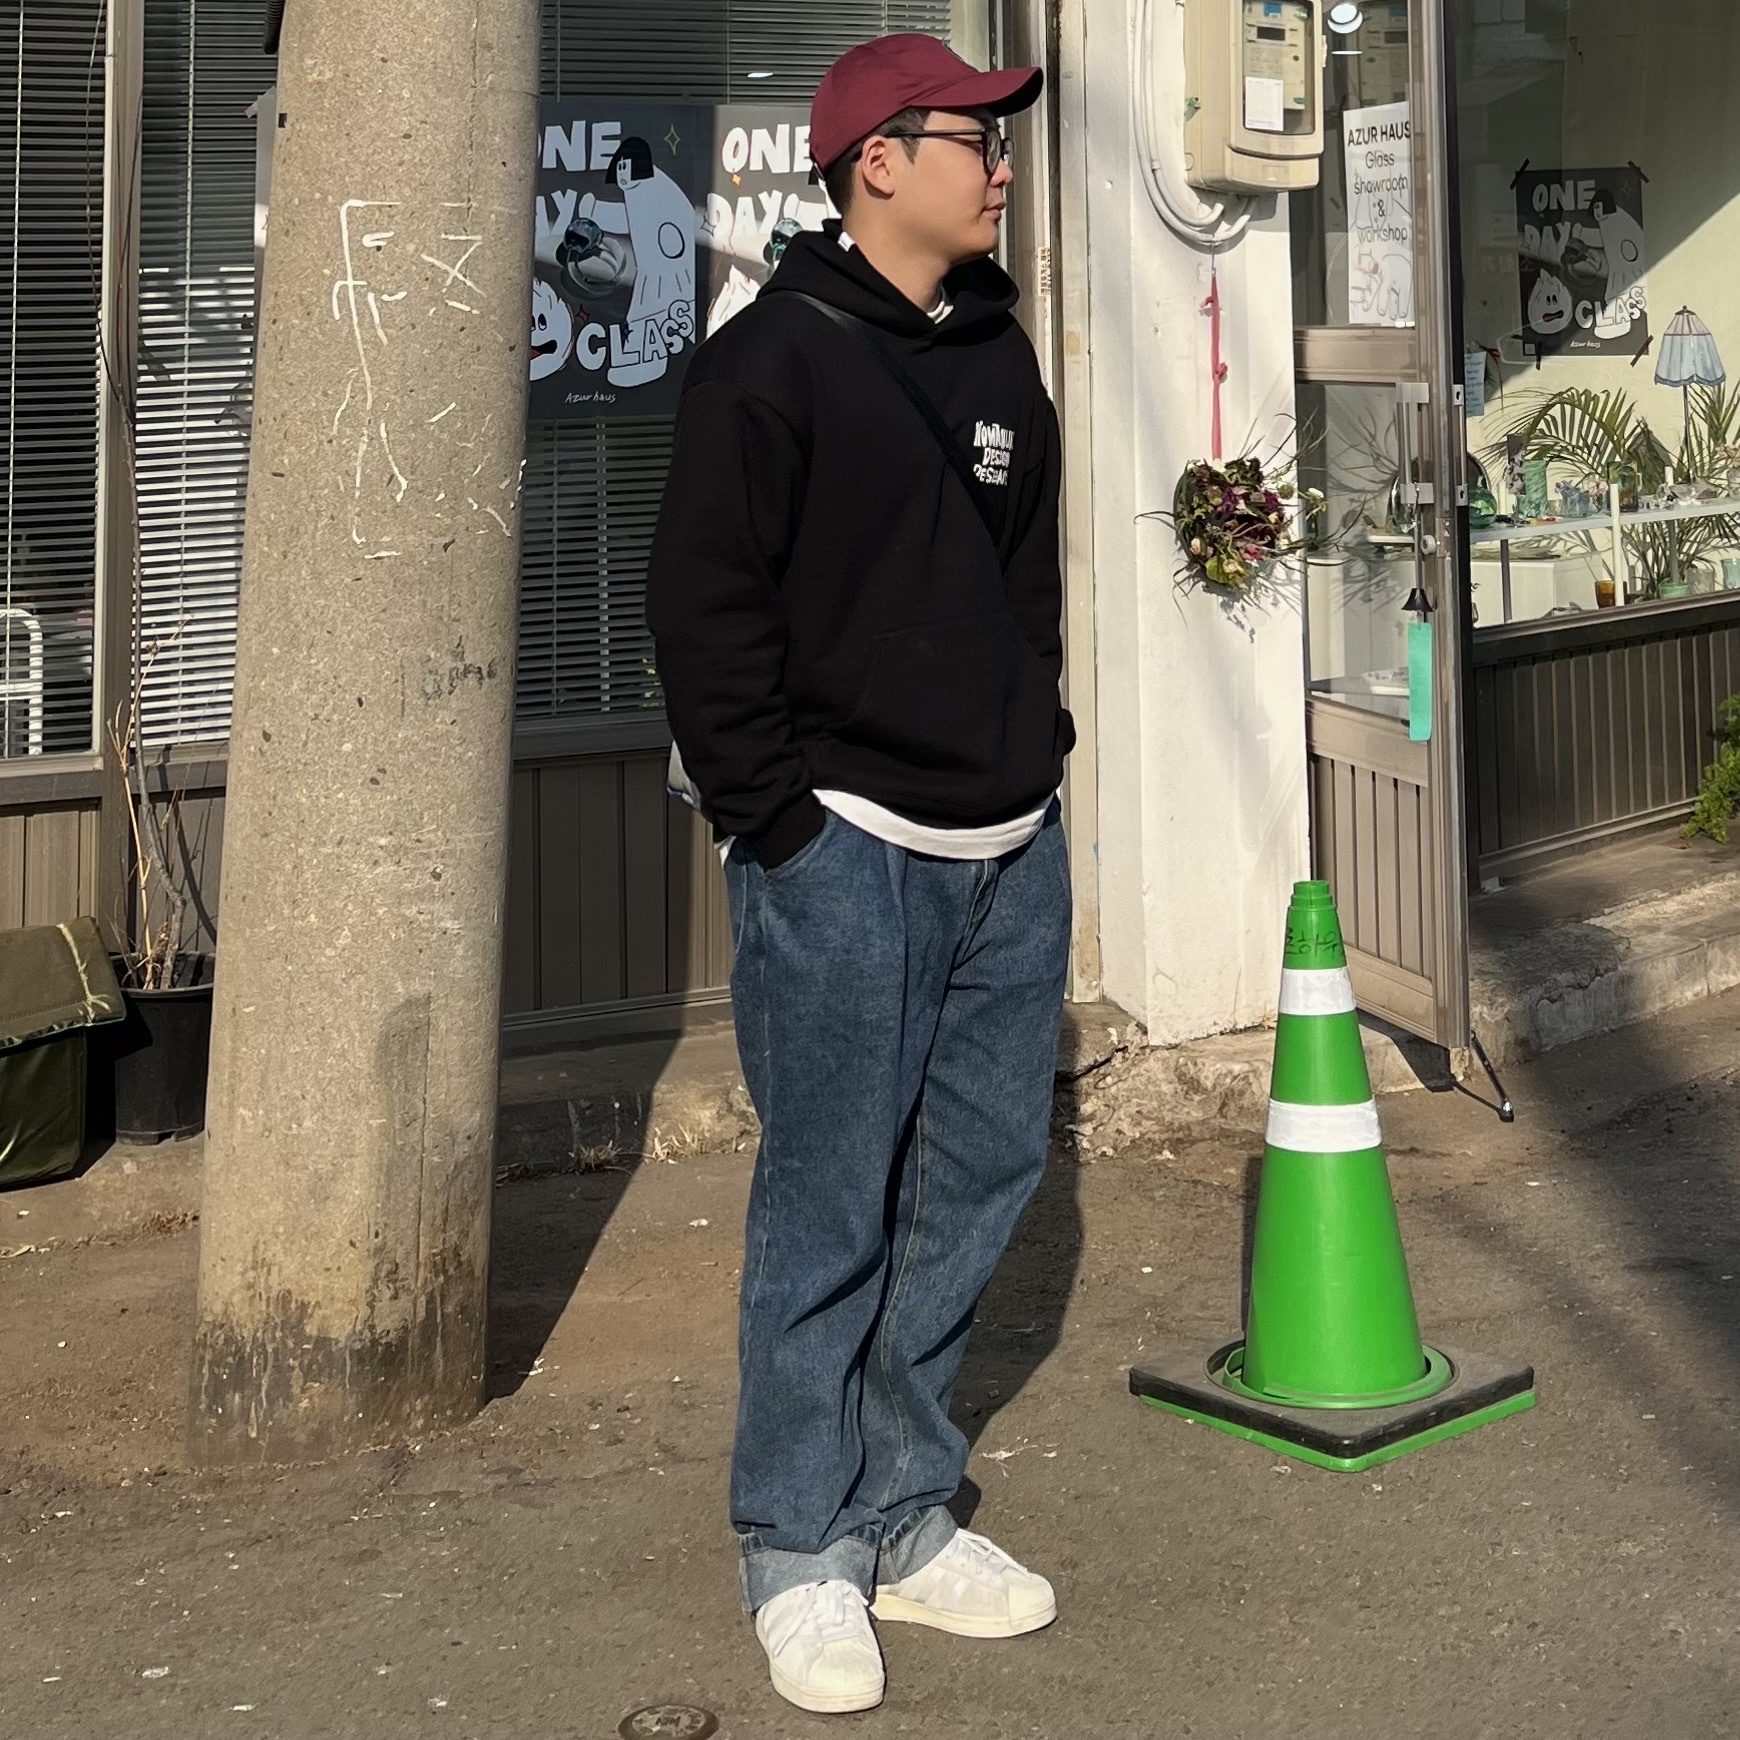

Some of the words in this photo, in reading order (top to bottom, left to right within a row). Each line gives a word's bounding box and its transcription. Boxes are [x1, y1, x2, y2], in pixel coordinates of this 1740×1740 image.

[537, 120, 622, 172] NE
[1347, 126, 1379, 147] AZUR
[1380, 120, 1411, 142] HAUS
[535, 189, 578, 236] AY
[707, 189, 783, 236] DAY
[1532, 179, 1596, 212] ONE
[1523, 221, 1571, 260] DAY
[1574, 285, 1647, 330] CLASS
[576, 300, 695, 371] CLASS
